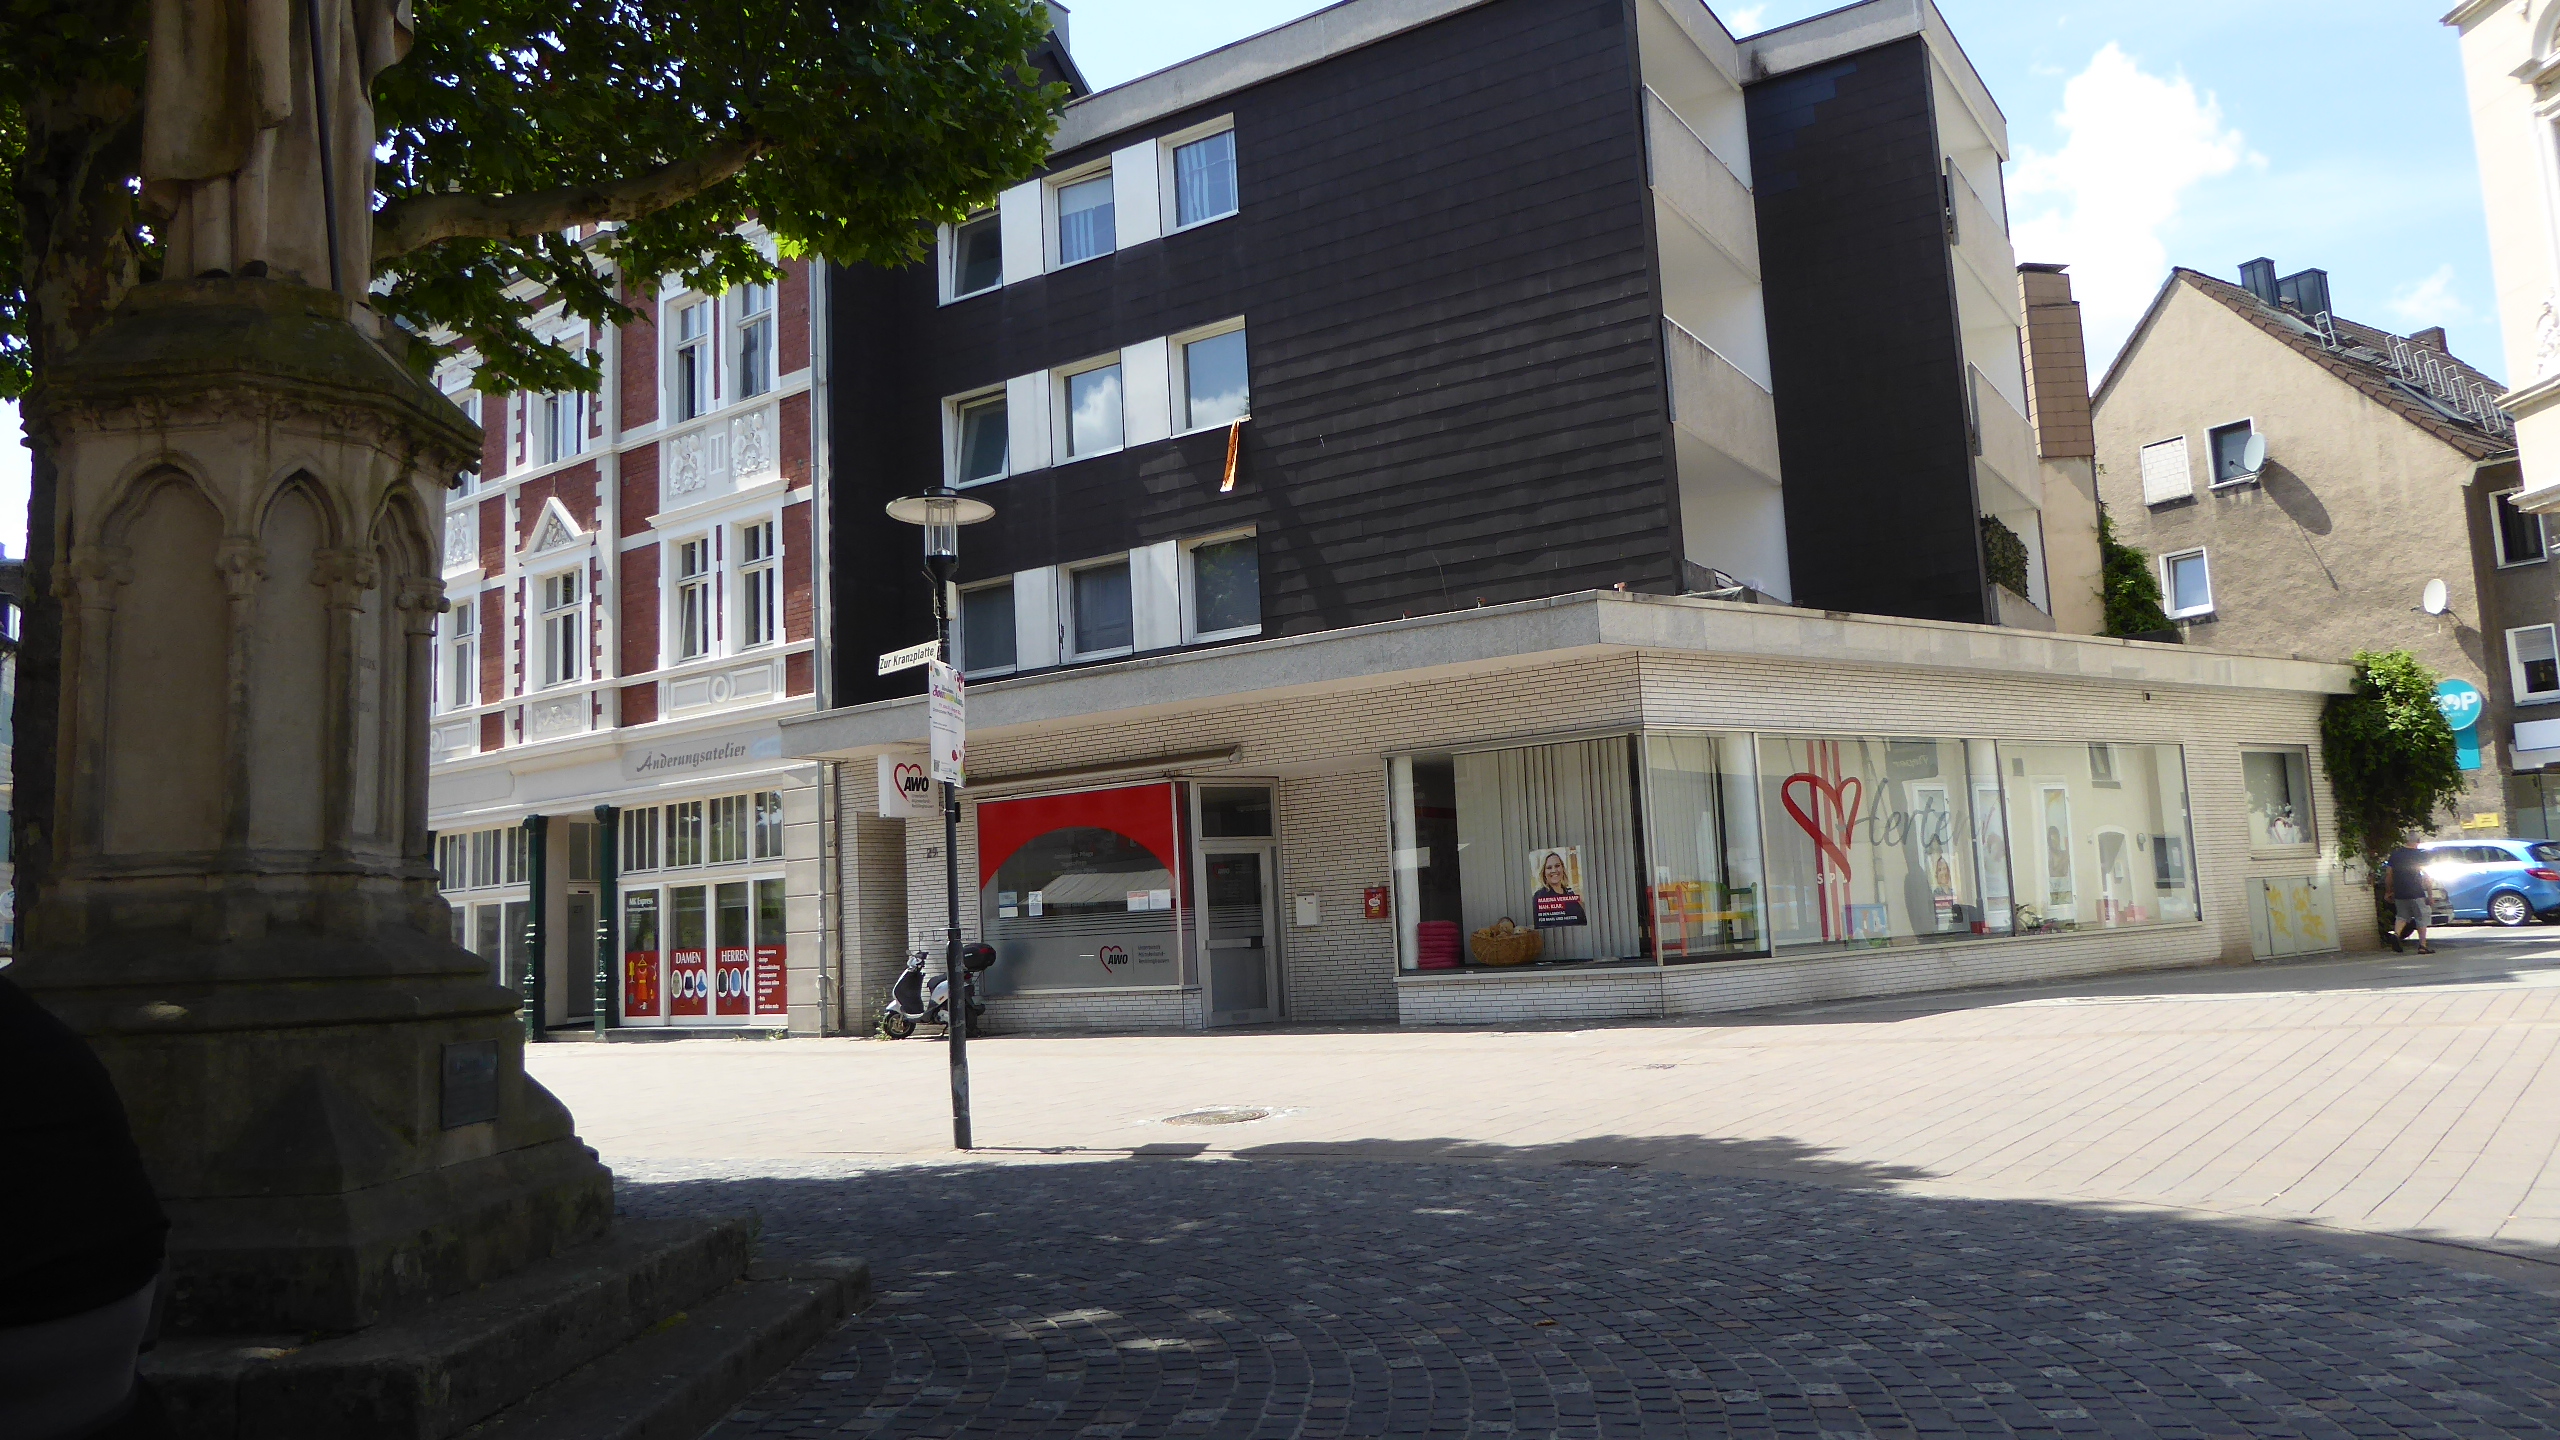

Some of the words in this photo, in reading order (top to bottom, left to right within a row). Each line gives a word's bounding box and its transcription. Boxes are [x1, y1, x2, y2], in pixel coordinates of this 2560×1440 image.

[879, 658, 891, 670] Zur
[893, 646, 935, 666] Kranzplatte
[636, 742, 746, 772] Änderungsatelier
[903, 776, 930, 792] AWO
[637, 896, 654, 907] Express
[675, 951, 702, 964] DAMEN
[721, 949, 749, 962] HERREN
[1108, 954, 1128, 965] AWO
